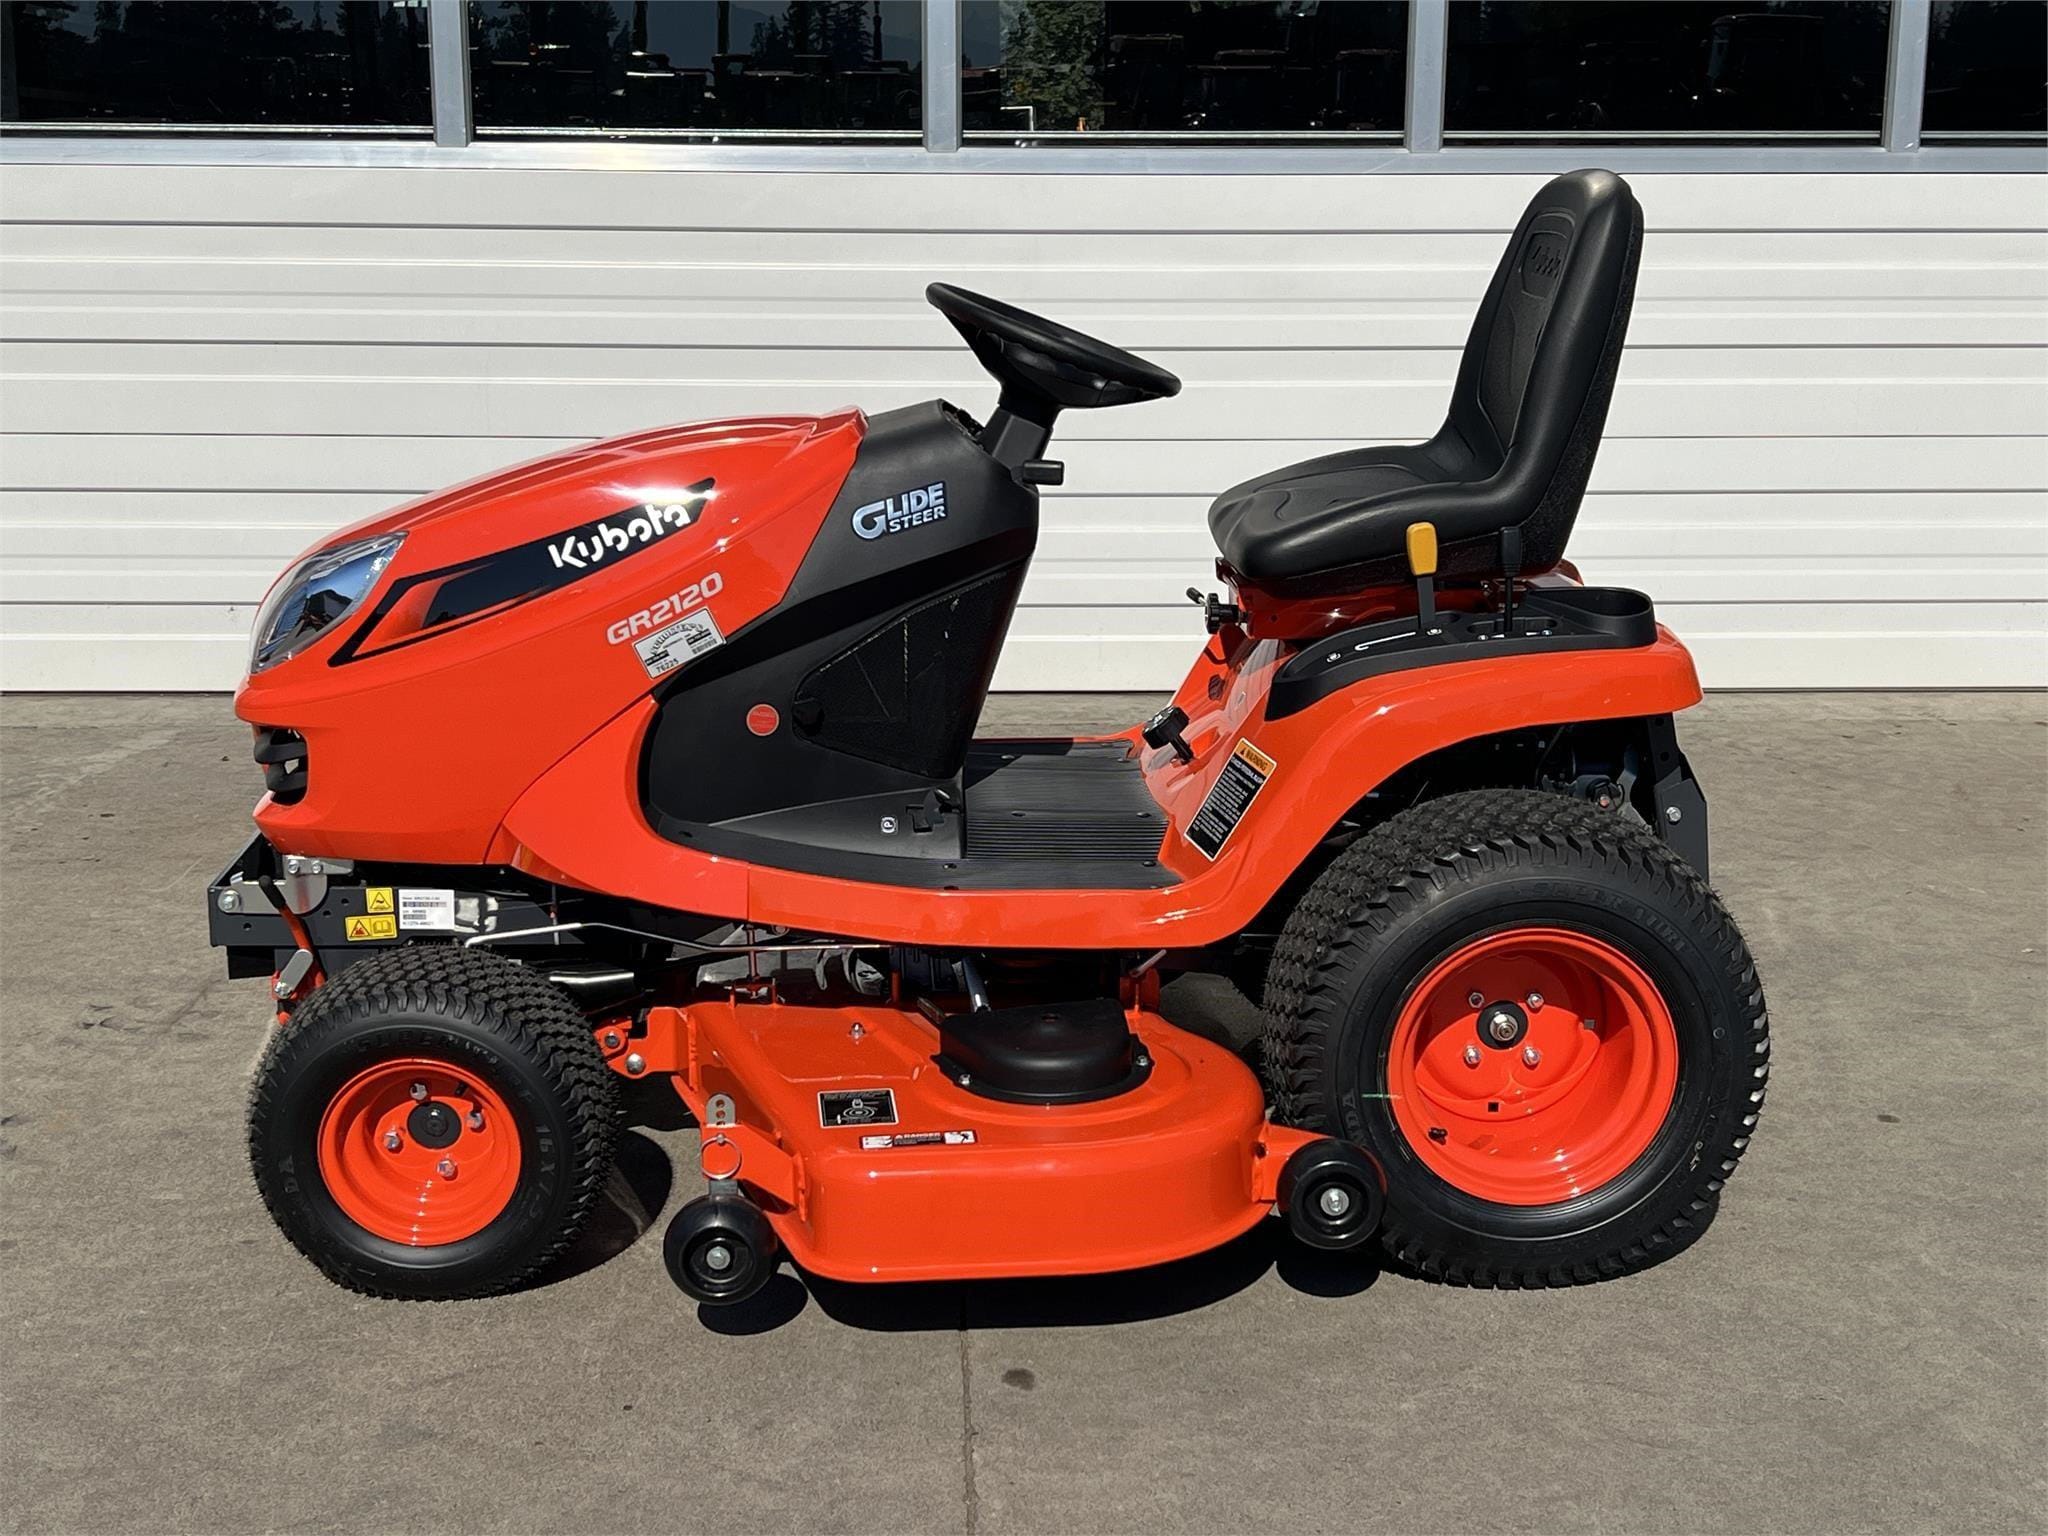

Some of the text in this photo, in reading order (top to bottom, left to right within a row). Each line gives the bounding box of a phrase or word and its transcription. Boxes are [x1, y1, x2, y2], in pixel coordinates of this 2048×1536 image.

[548, 503, 691, 568] Kubota
[852, 482, 944, 541] GLIDE
[888, 505, 946, 533] STEER
[606, 572, 723, 645] GR2120
[1245, 747, 1269, 773] WARNING
